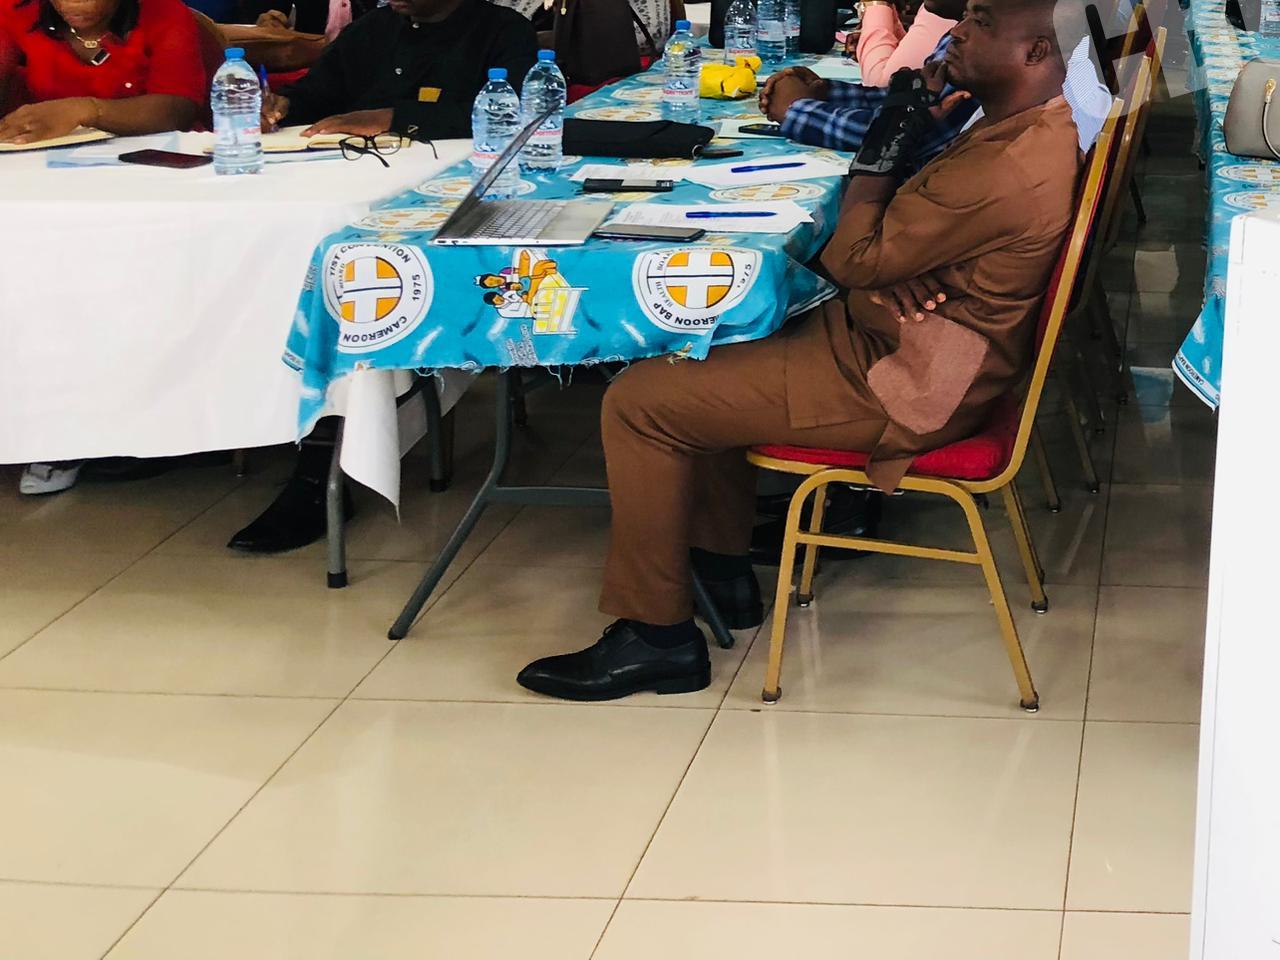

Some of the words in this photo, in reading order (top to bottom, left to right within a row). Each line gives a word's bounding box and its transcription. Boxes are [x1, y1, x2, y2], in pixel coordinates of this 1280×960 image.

[412, 274, 422, 301] 1975
[653, 303, 673, 320] BAP
[674, 315, 719, 326] EROON
[343, 316, 407, 342] CAMEROON
